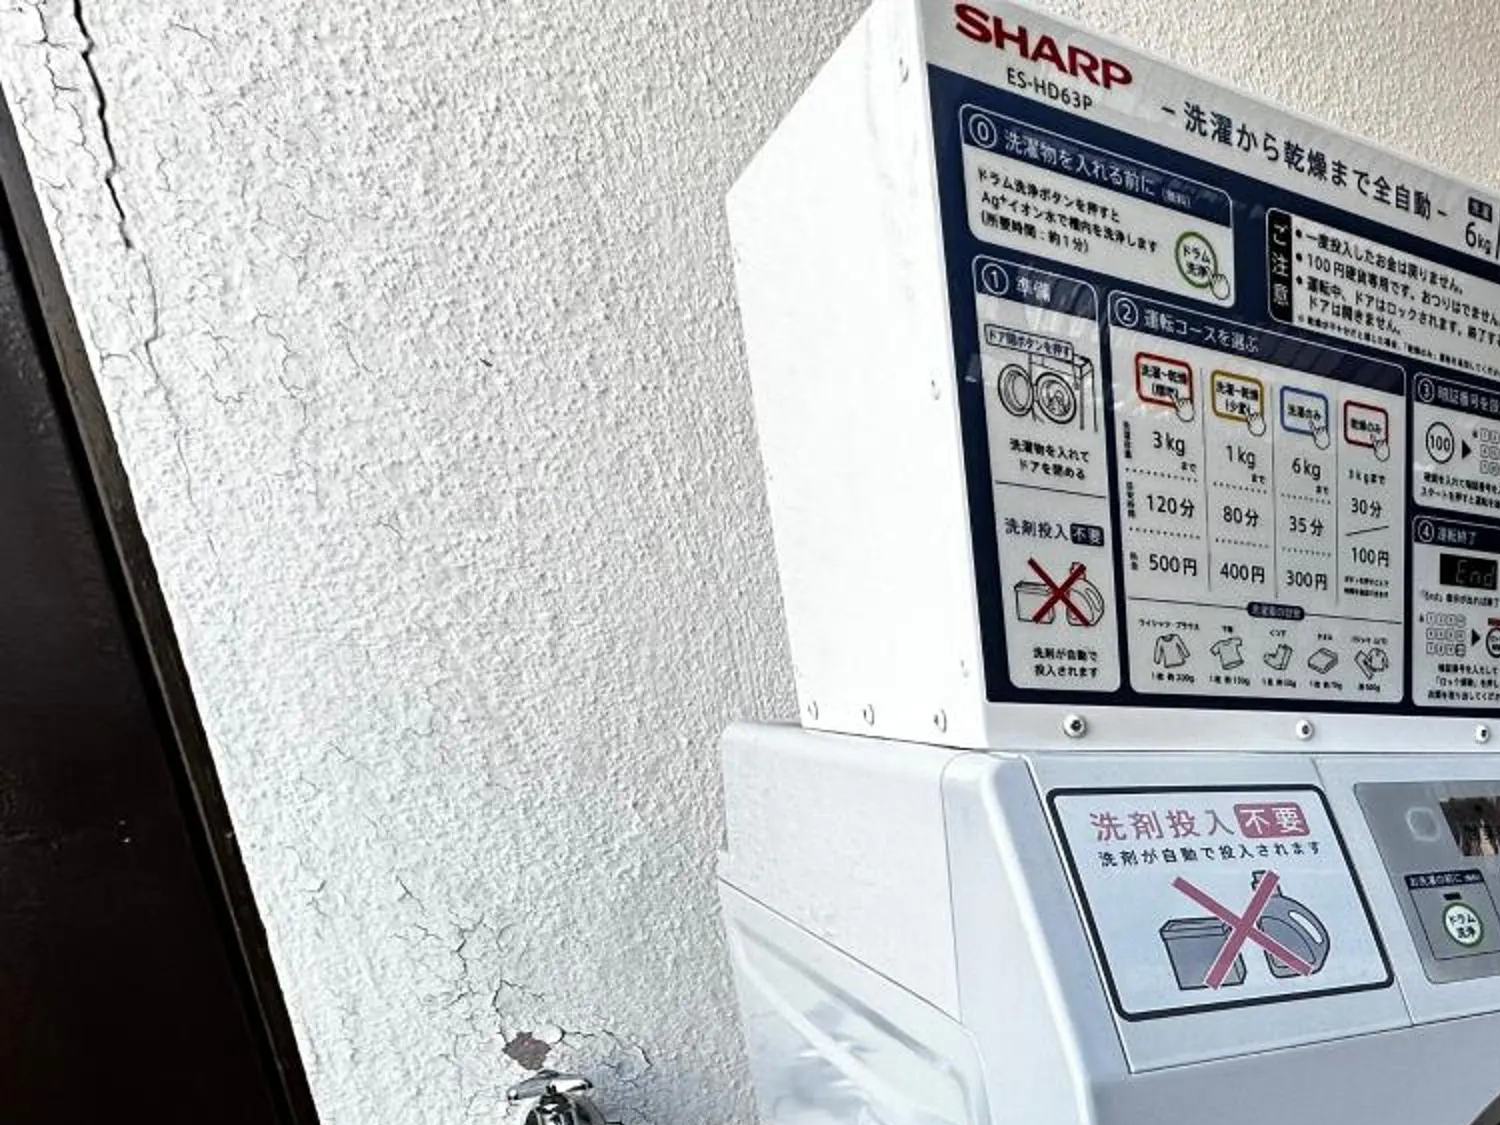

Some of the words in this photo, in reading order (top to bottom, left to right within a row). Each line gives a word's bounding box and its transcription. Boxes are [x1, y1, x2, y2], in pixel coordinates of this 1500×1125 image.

[954, 3, 1133, 90] SHARP
[1006, 67, 1093, 111] ES-HD63P
[1003, 128, 1155, 196] 洗濯物を入れる前に
[978, 168, 1121, 223] ドラム洗浄ボタンを押すと
[1465, 222, 1491, 256] 6kg
[1143, 308, 1259, 353] 運転コースを選ぶ
[1153, 432, 1186, 457] 3kg
[1429, 434, 1451, 452] 100
[1226, 445, 1256, 469] 1kg
[1291, 458, 1322, 480] 6kg
[1147, 495, 1195, 519] 120分
[1223, 506, 1259, 528] 80分
[1351, 499, 1383, 519] 30分
[1004, 517, 1068, 541] 洗剤投入
[1289, 515, 1325, 537] 35分
[1149, 554, 1198, 577] 500円
[1352, 546, 1390, 568] 100円
[1220, 562, 1265, 584] 400円
[1286, 569, 1328, 591] 300円
[1455, 559, 1496, 586] End
[1089, 808, 1236, 842] 洗剤投入
[1239, 805, 1305, 835] 不要
[1098, 840, 1321, 867] 洗剤が自動で投入されます
